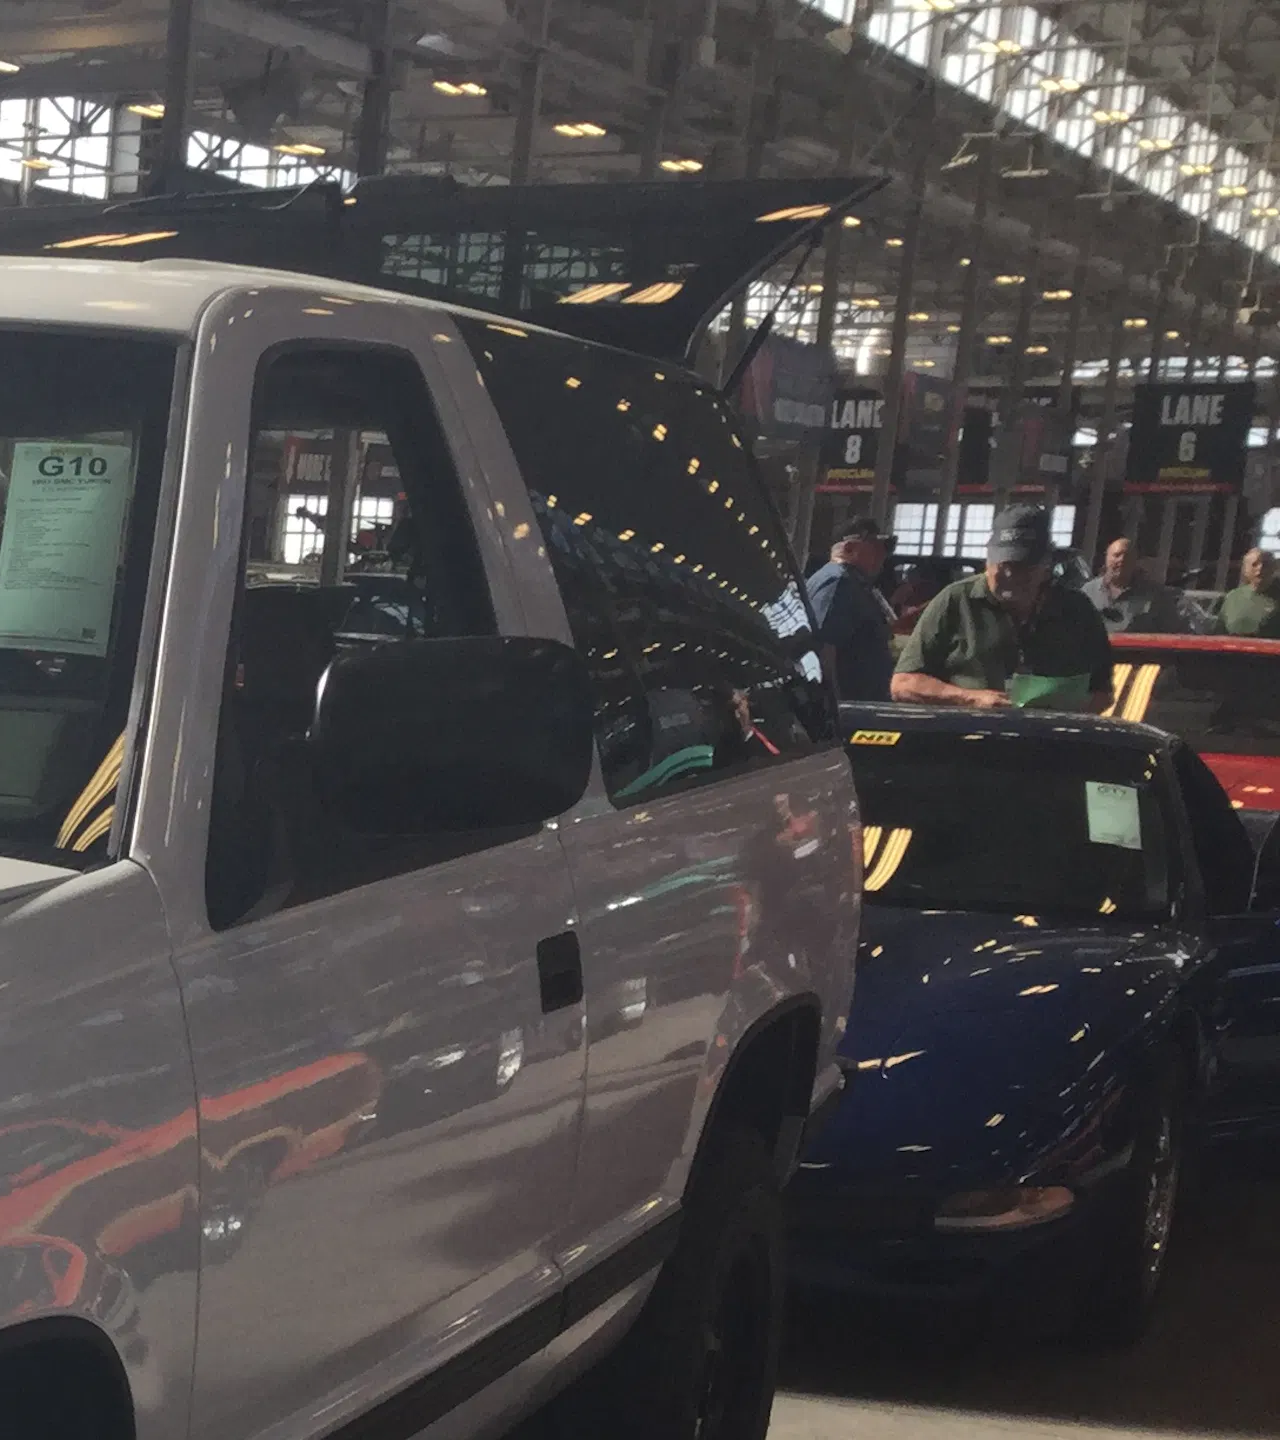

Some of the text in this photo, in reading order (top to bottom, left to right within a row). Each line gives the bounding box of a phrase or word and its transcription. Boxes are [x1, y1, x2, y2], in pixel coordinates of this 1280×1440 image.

[831, 399, 886, 429] LANE
[1160, 394, 1225, 426] LANE
[844, 434, 862, 464] 8
[1178, 431, 1197, 462] 6
[38, 456, 108, 477] G10
